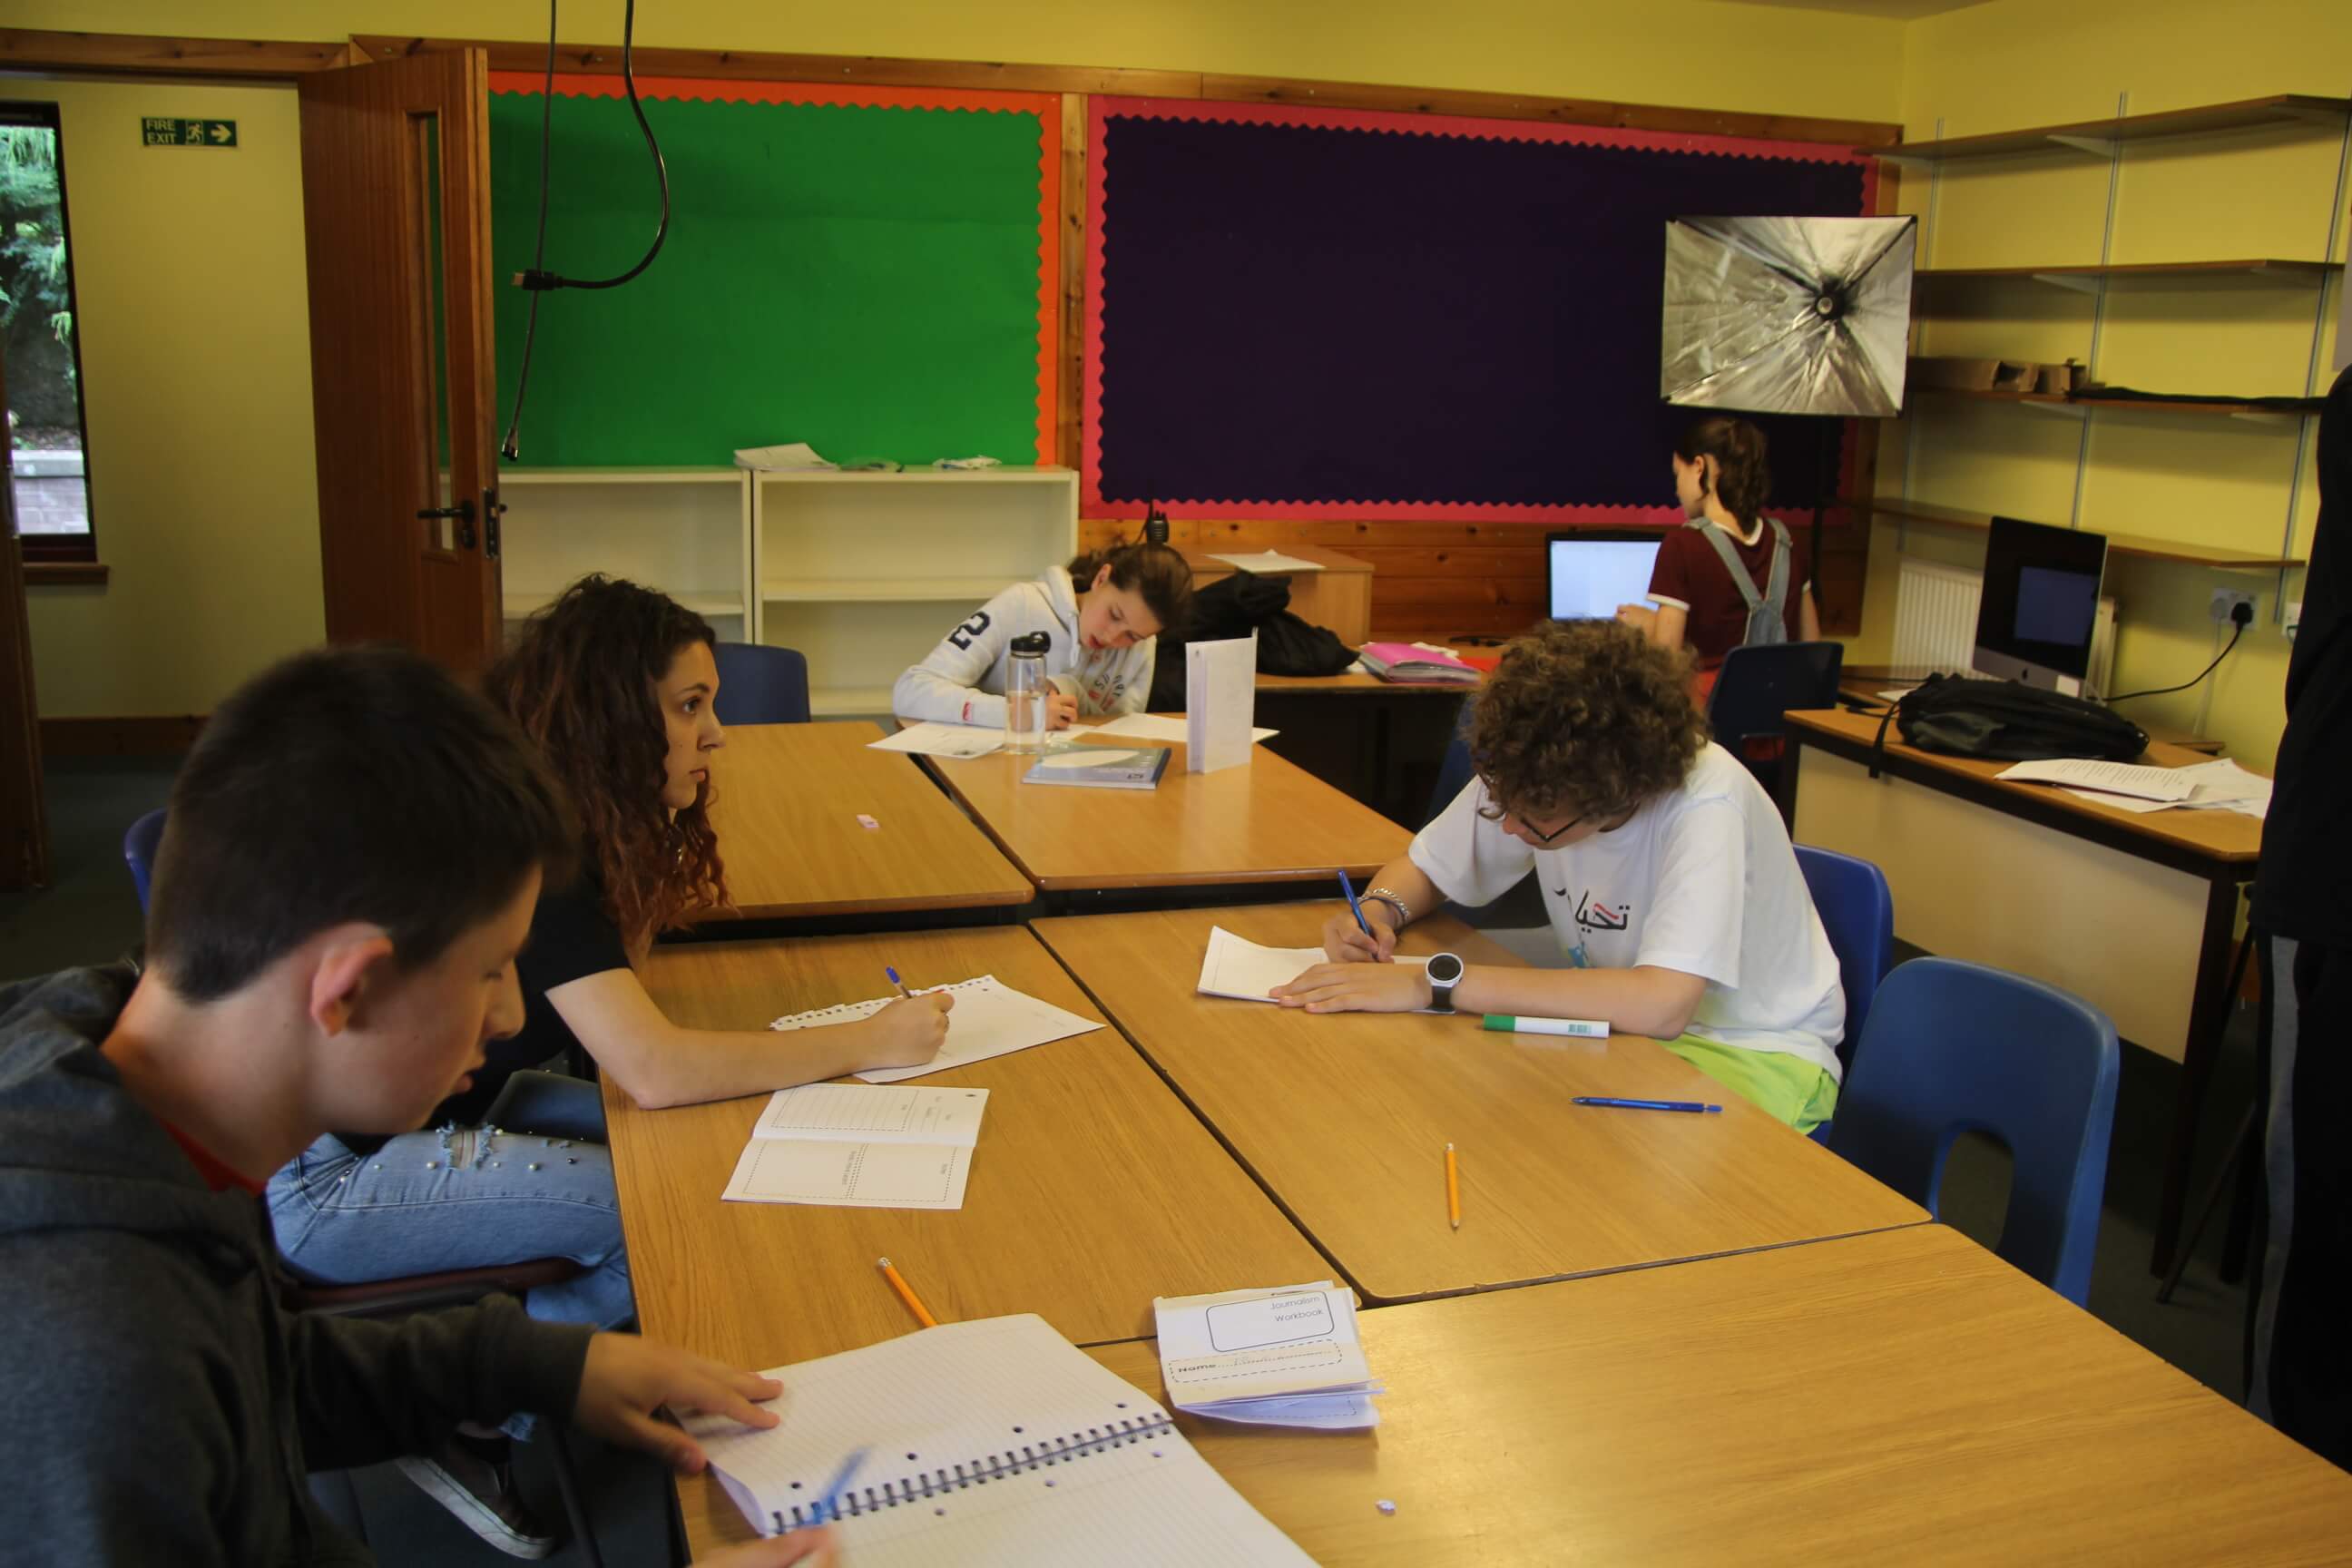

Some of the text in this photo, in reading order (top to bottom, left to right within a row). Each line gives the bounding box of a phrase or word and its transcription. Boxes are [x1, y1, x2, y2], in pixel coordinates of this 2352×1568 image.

[146, 119, 175, 131] FIRE
[147, 132, 177, 144] EXIT
[948, 611, 990, 651] 2
[1270, 1297, 1320, 1309] Journalism
[1275, 1309, 1324, 1321] Workbook
